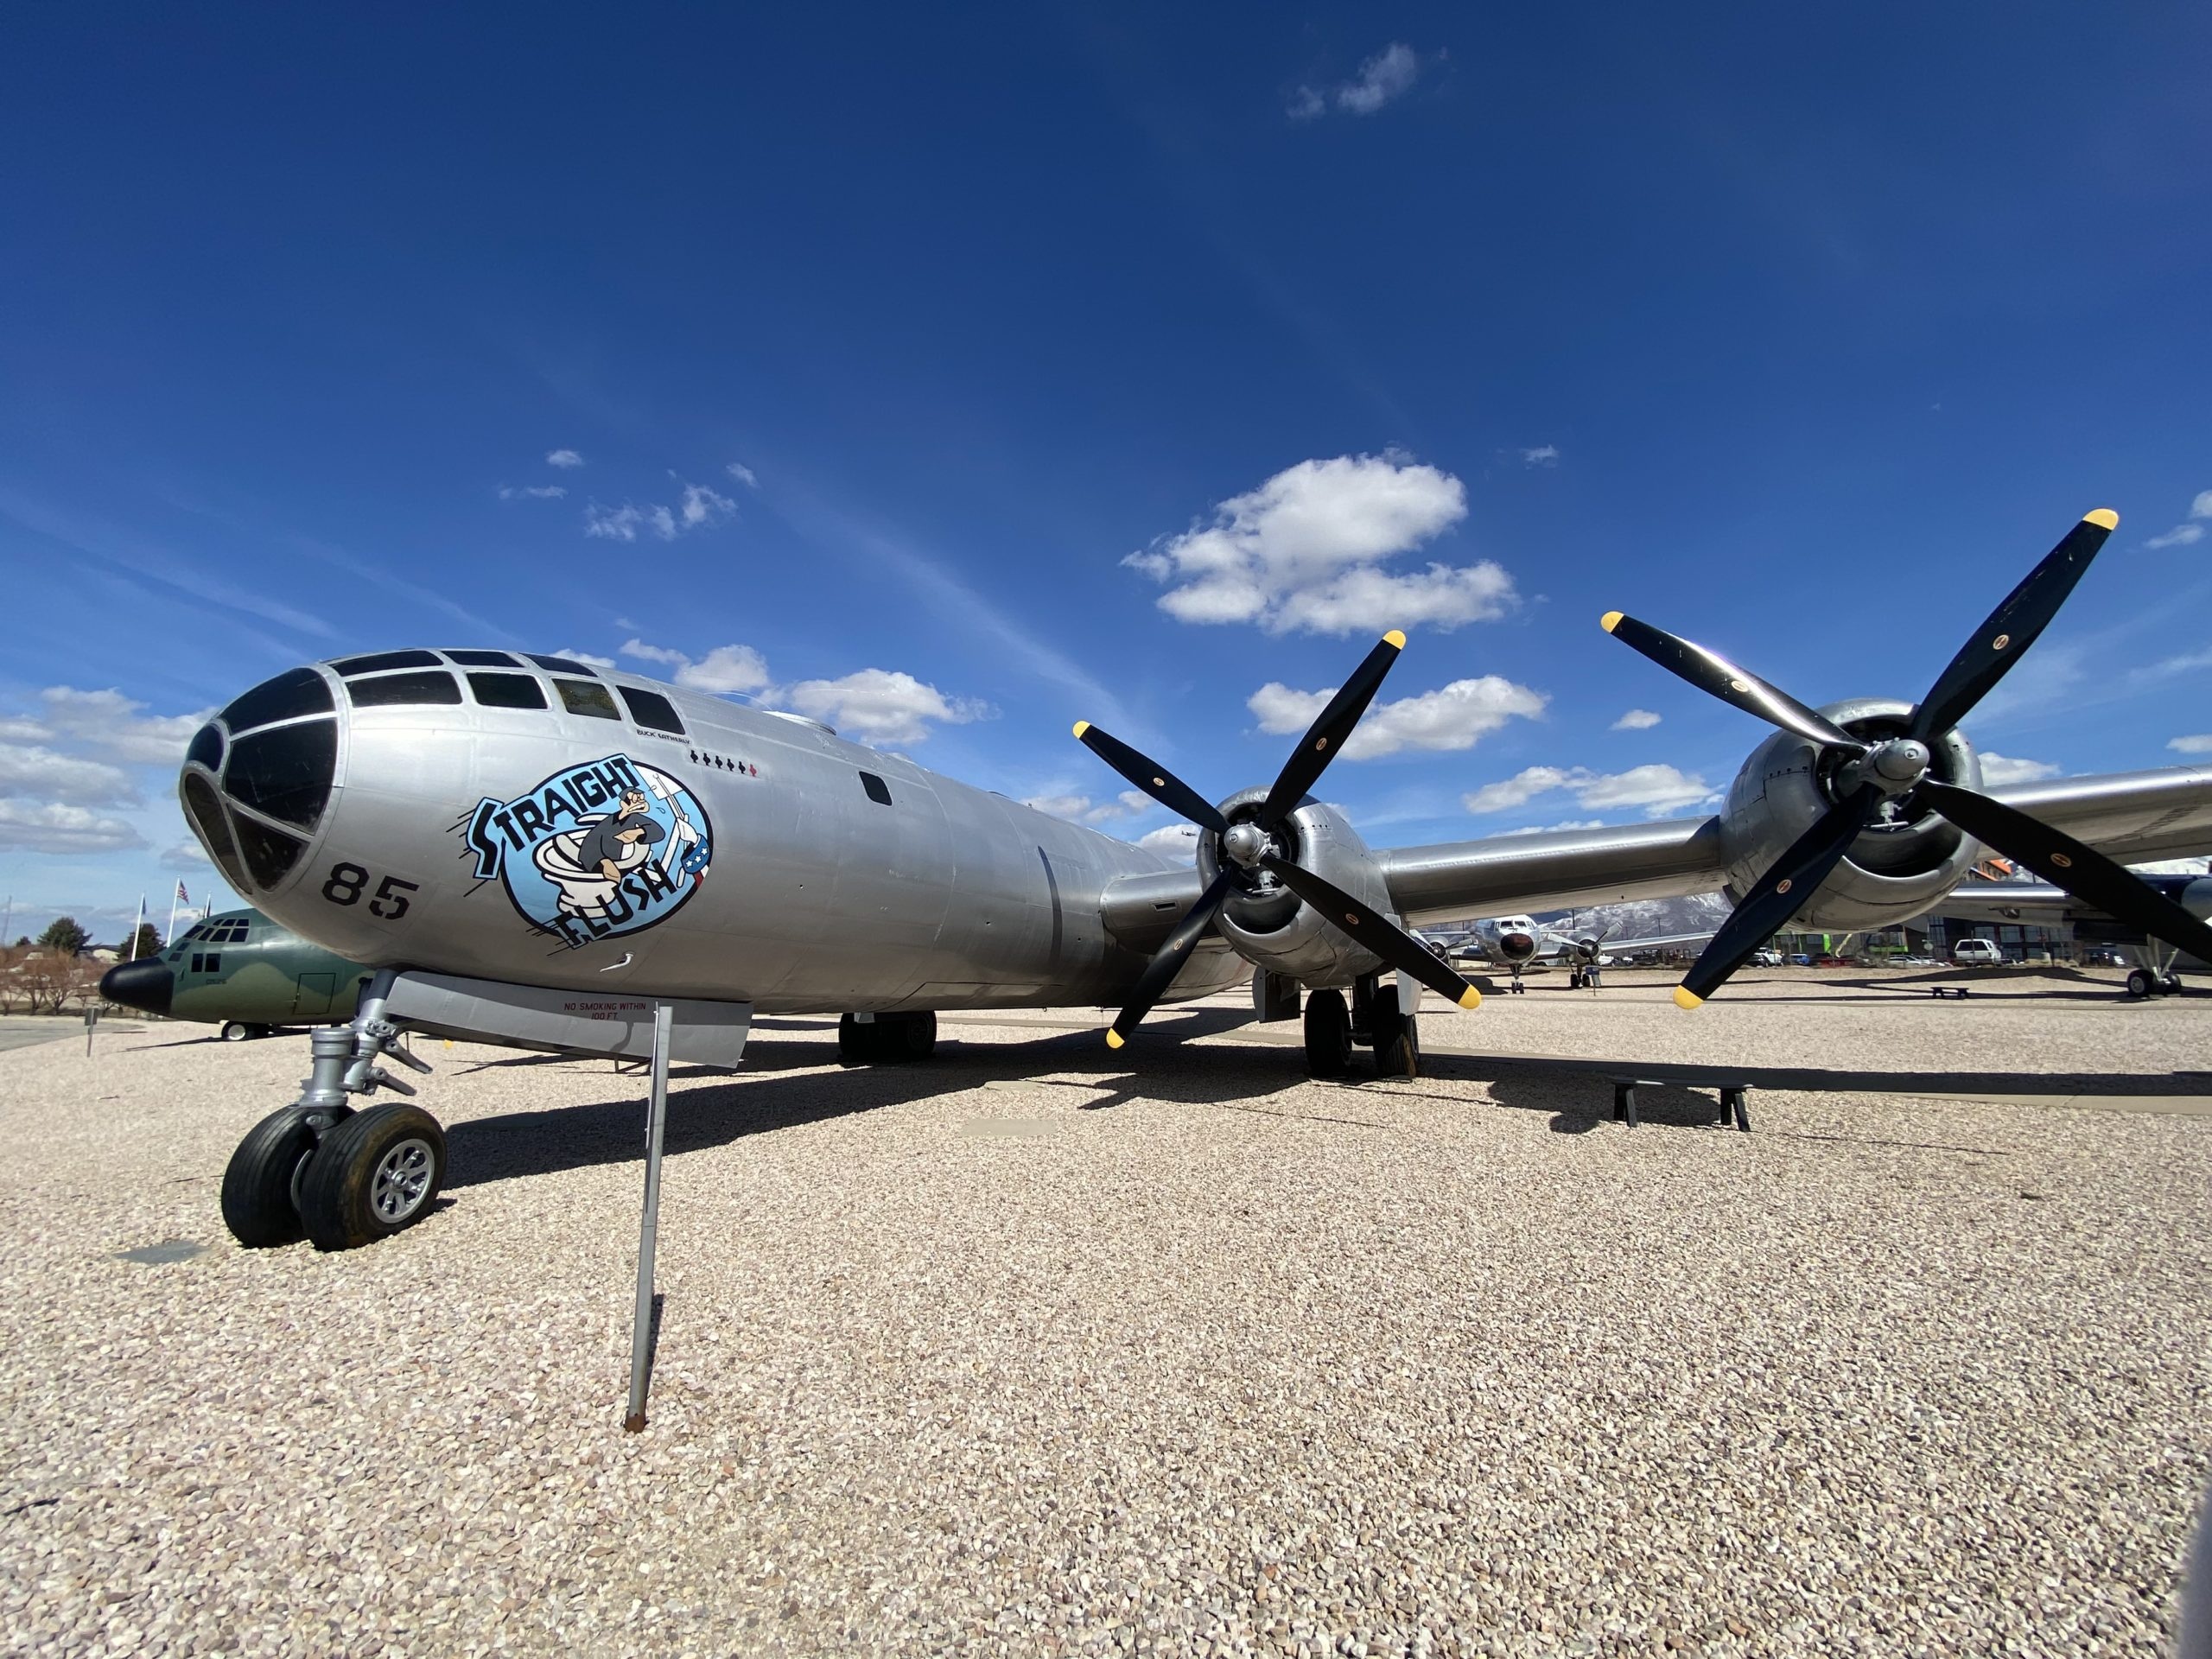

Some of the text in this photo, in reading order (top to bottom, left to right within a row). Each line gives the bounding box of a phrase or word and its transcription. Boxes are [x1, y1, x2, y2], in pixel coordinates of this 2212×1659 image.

[472, 757, 640, 875] STRAIGHT
[322, 862, 420, 920] 85
[554, 858, 677, 945] FLUSH
[591, 1012, 605, 1020] 100
